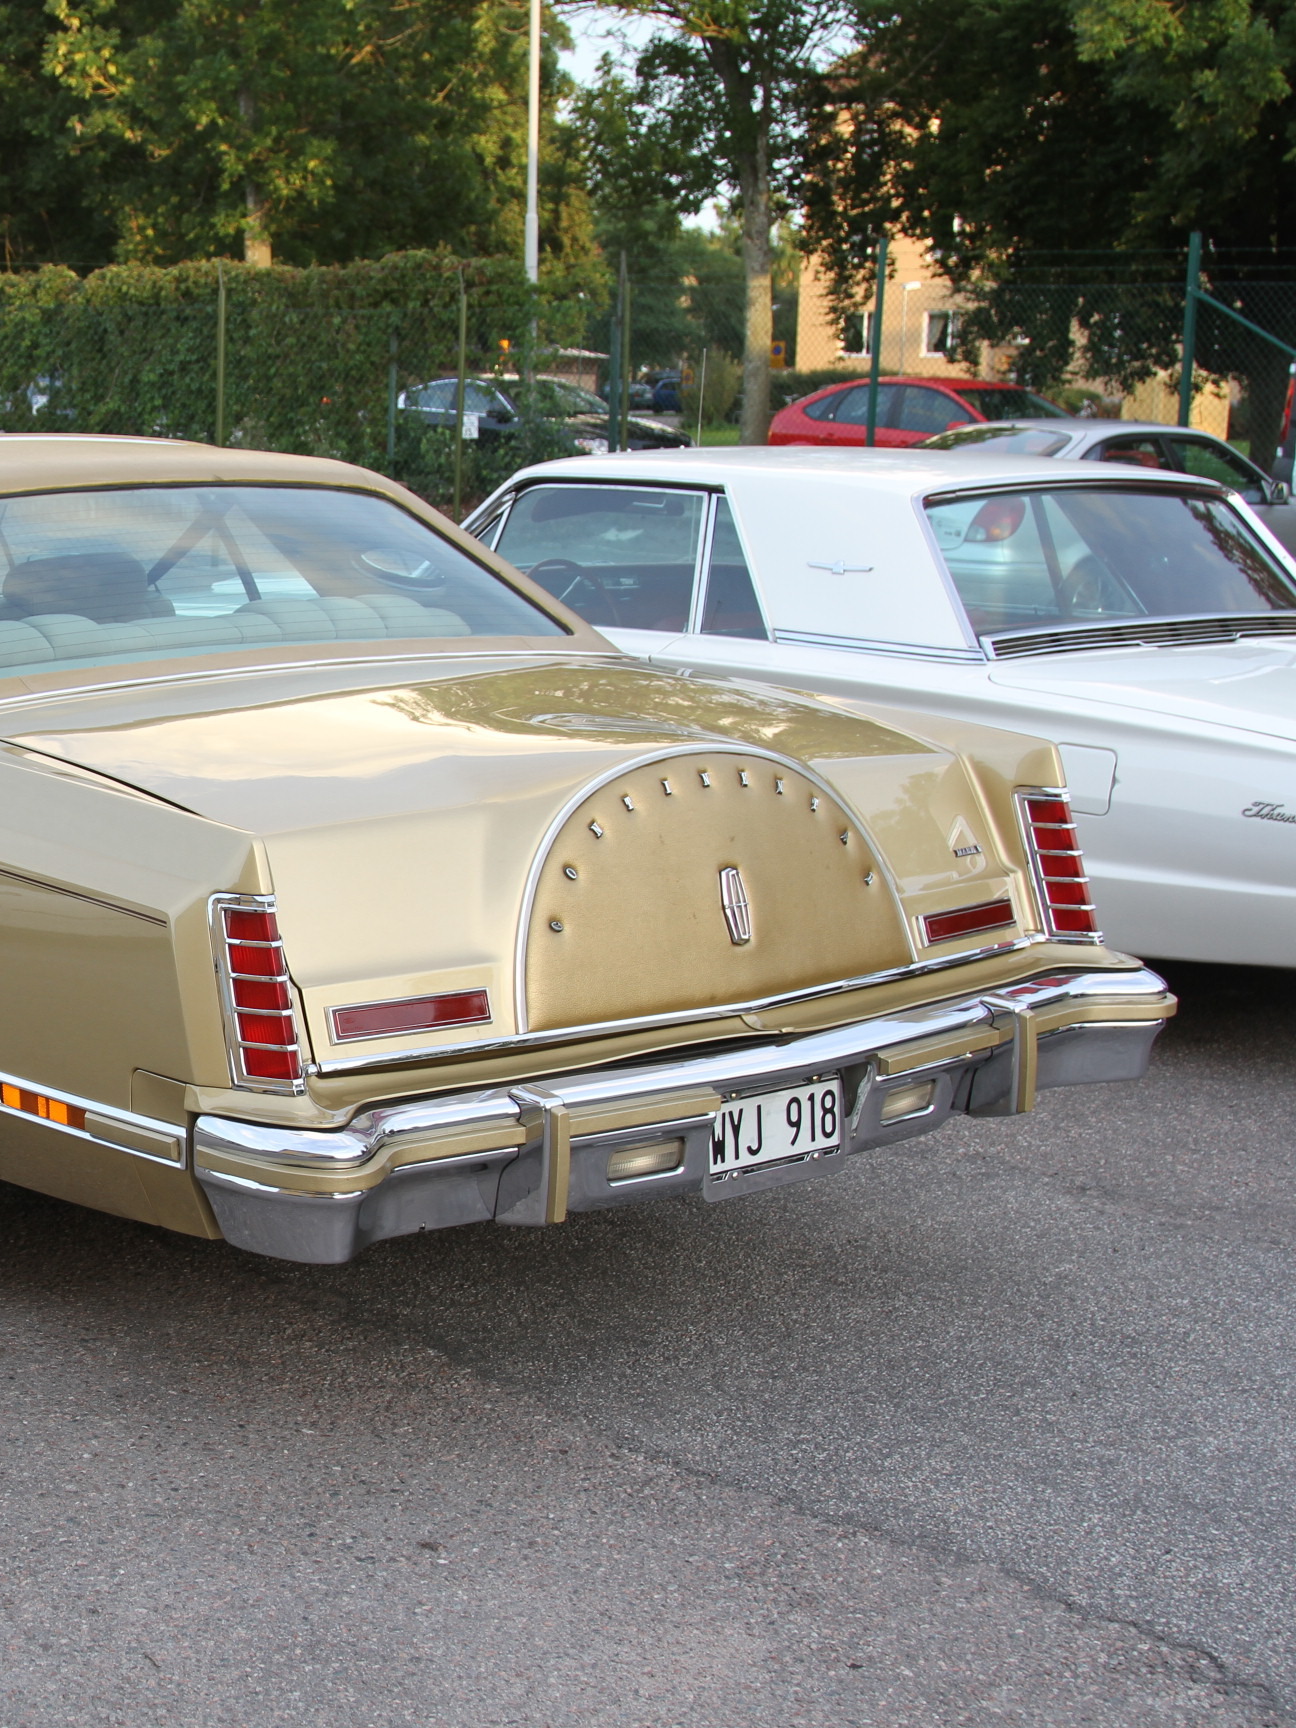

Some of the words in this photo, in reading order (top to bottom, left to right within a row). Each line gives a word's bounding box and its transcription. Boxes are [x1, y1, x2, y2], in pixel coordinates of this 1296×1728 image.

[549, 768, 874, 933] CONTINENTAL
[711, 1104, 763, 1165] WYJ
[786, 1089, 837, 1146] 918
